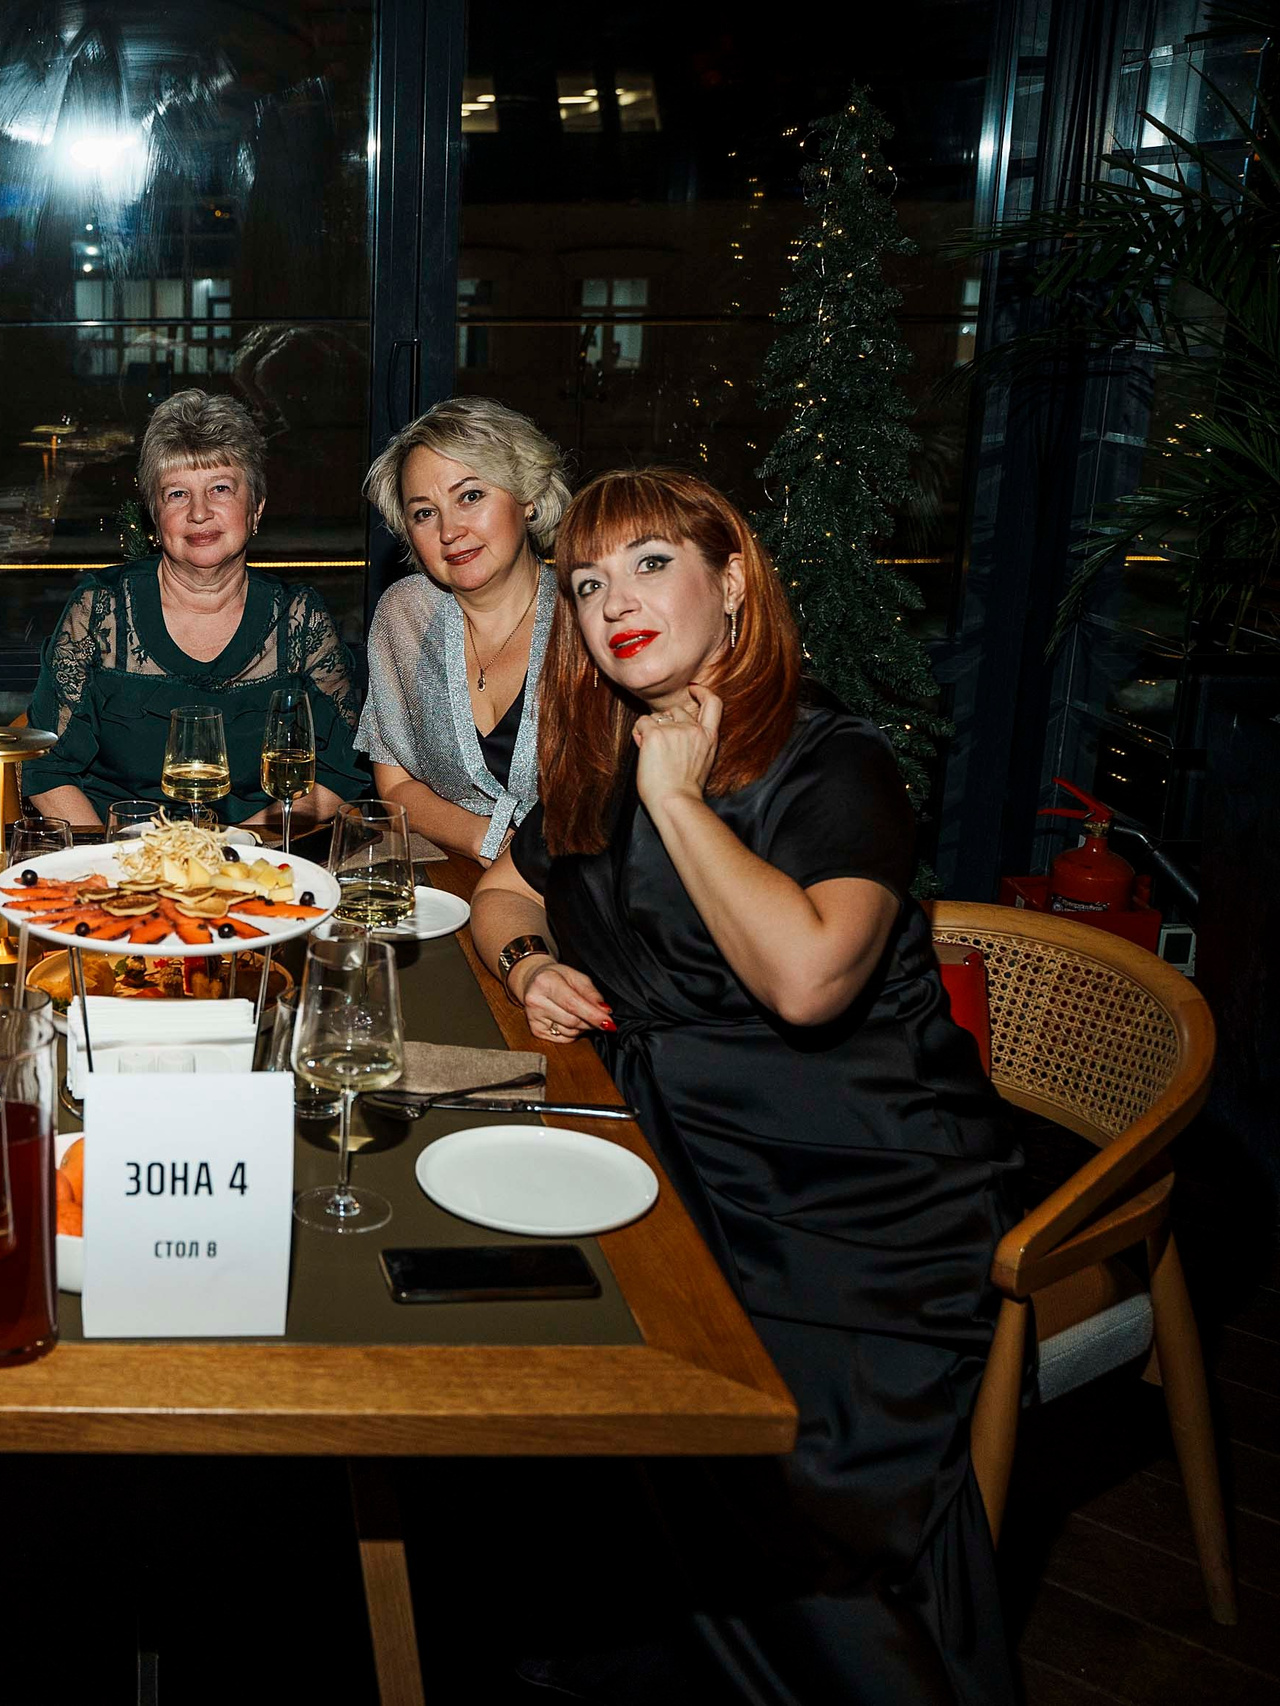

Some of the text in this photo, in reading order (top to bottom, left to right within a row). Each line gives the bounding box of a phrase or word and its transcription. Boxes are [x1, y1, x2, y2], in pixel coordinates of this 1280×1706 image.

[125, 1161, 248, 1197] ЗОНА 4
[154, 1241, 218, 1258] СТОЛ 8
